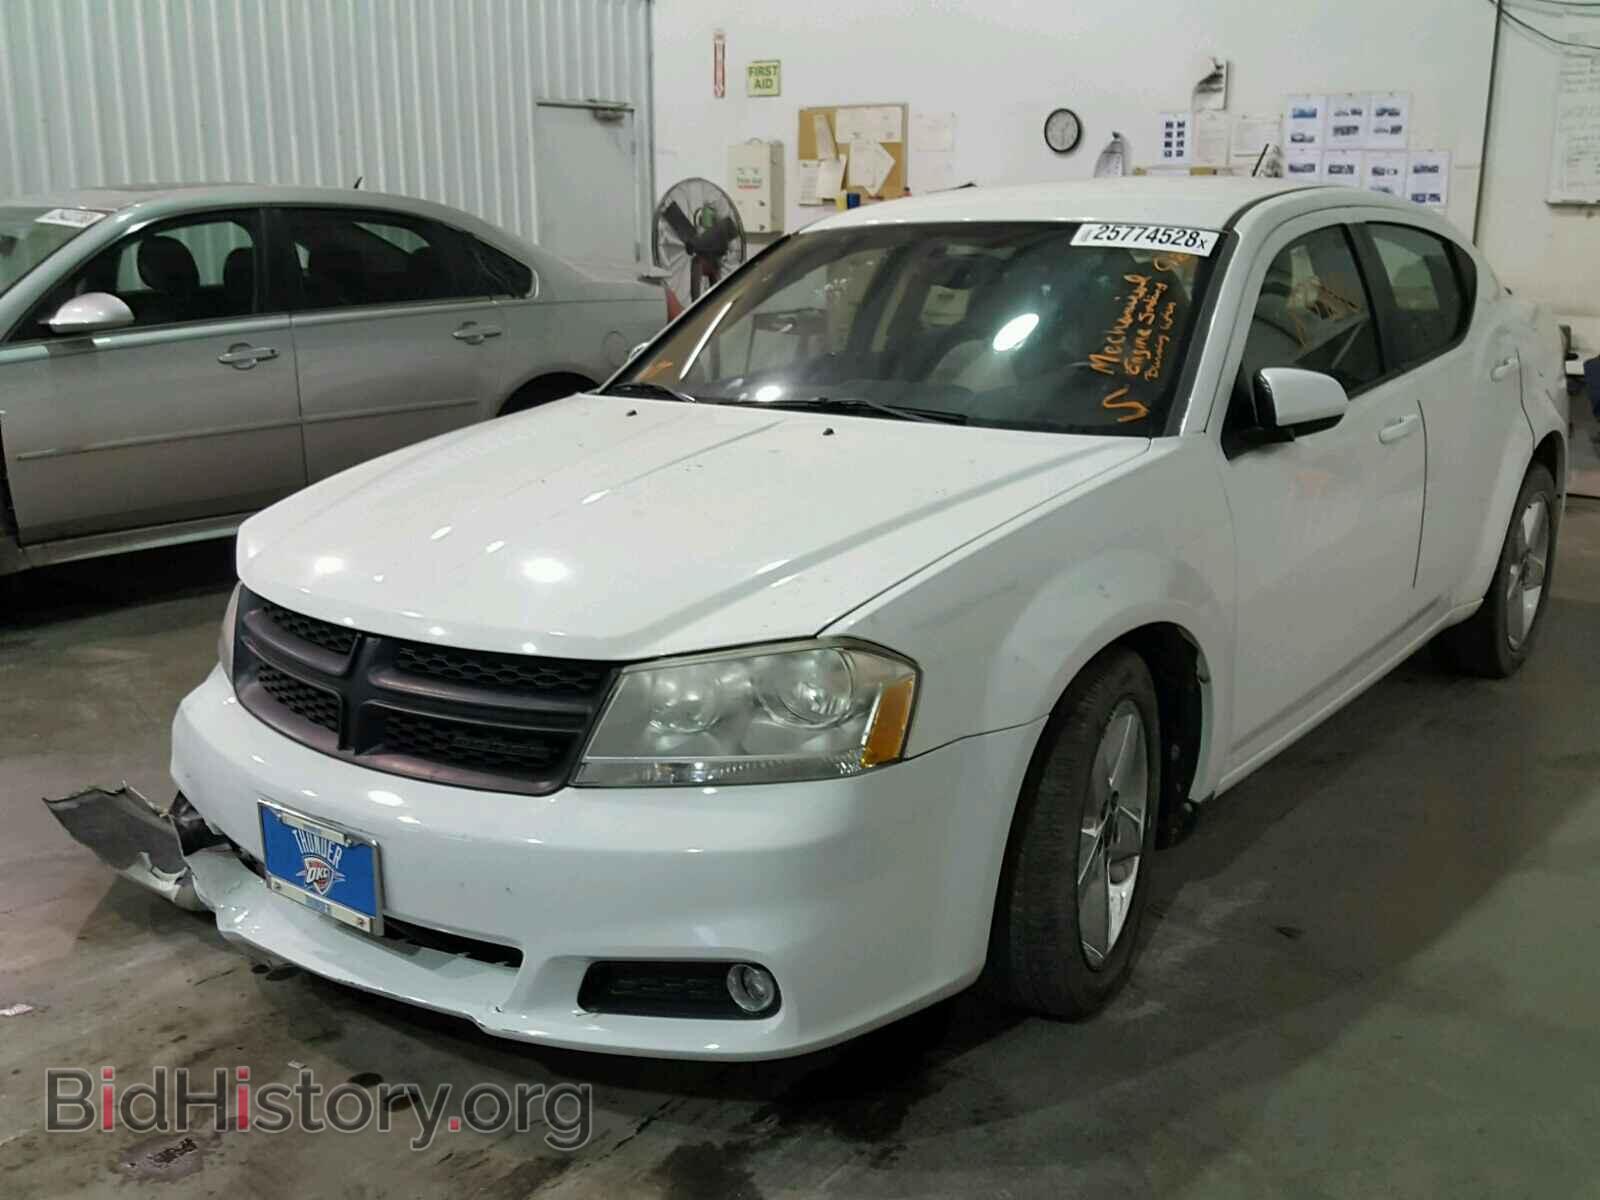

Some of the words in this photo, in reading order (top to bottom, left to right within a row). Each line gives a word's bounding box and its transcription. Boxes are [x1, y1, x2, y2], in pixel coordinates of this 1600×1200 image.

[748, 65, 777, 77] FIRST
[754, 79, 773, 89] AID
[292, 828, 343, 869] THUNDER
